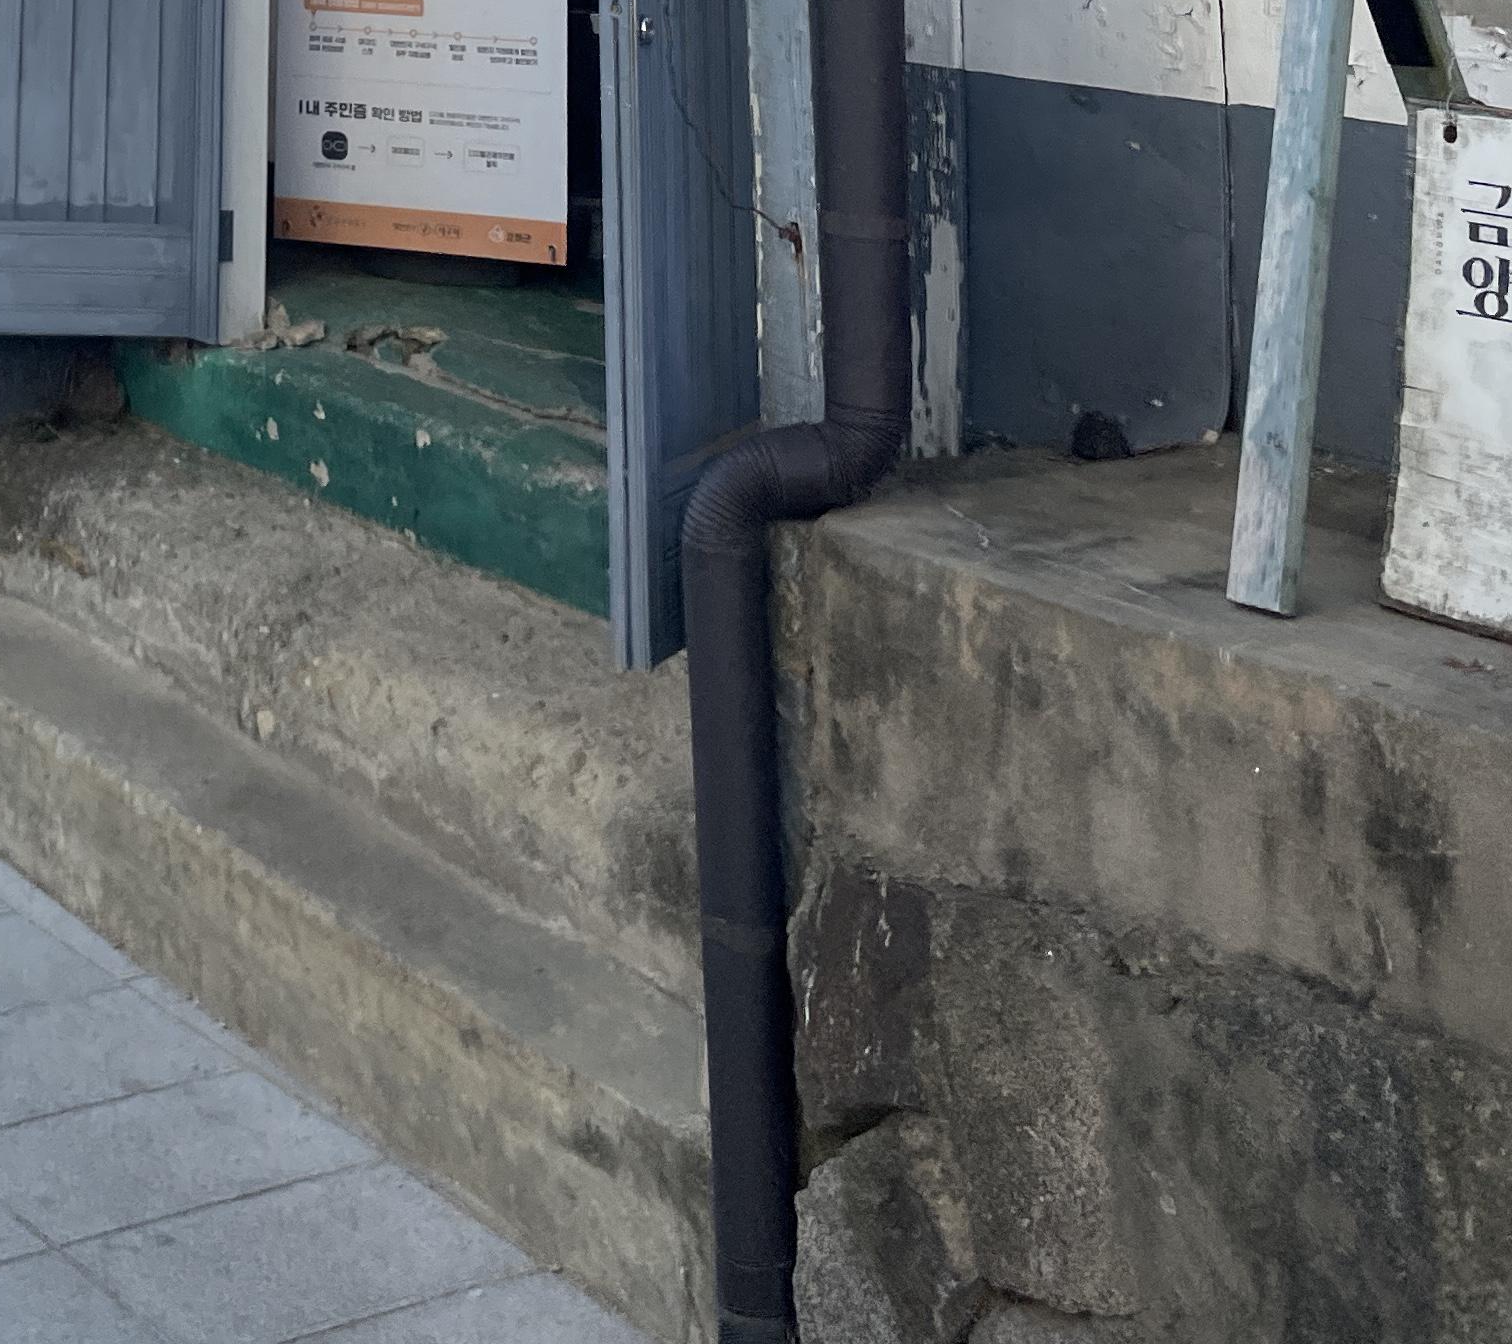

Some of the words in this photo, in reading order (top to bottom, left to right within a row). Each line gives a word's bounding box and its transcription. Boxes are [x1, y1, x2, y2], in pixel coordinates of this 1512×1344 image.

[305, 99, 320, 116] 내
[324, 100, 367, 120] 주민증
[371, 105, 395, 122] 확인
